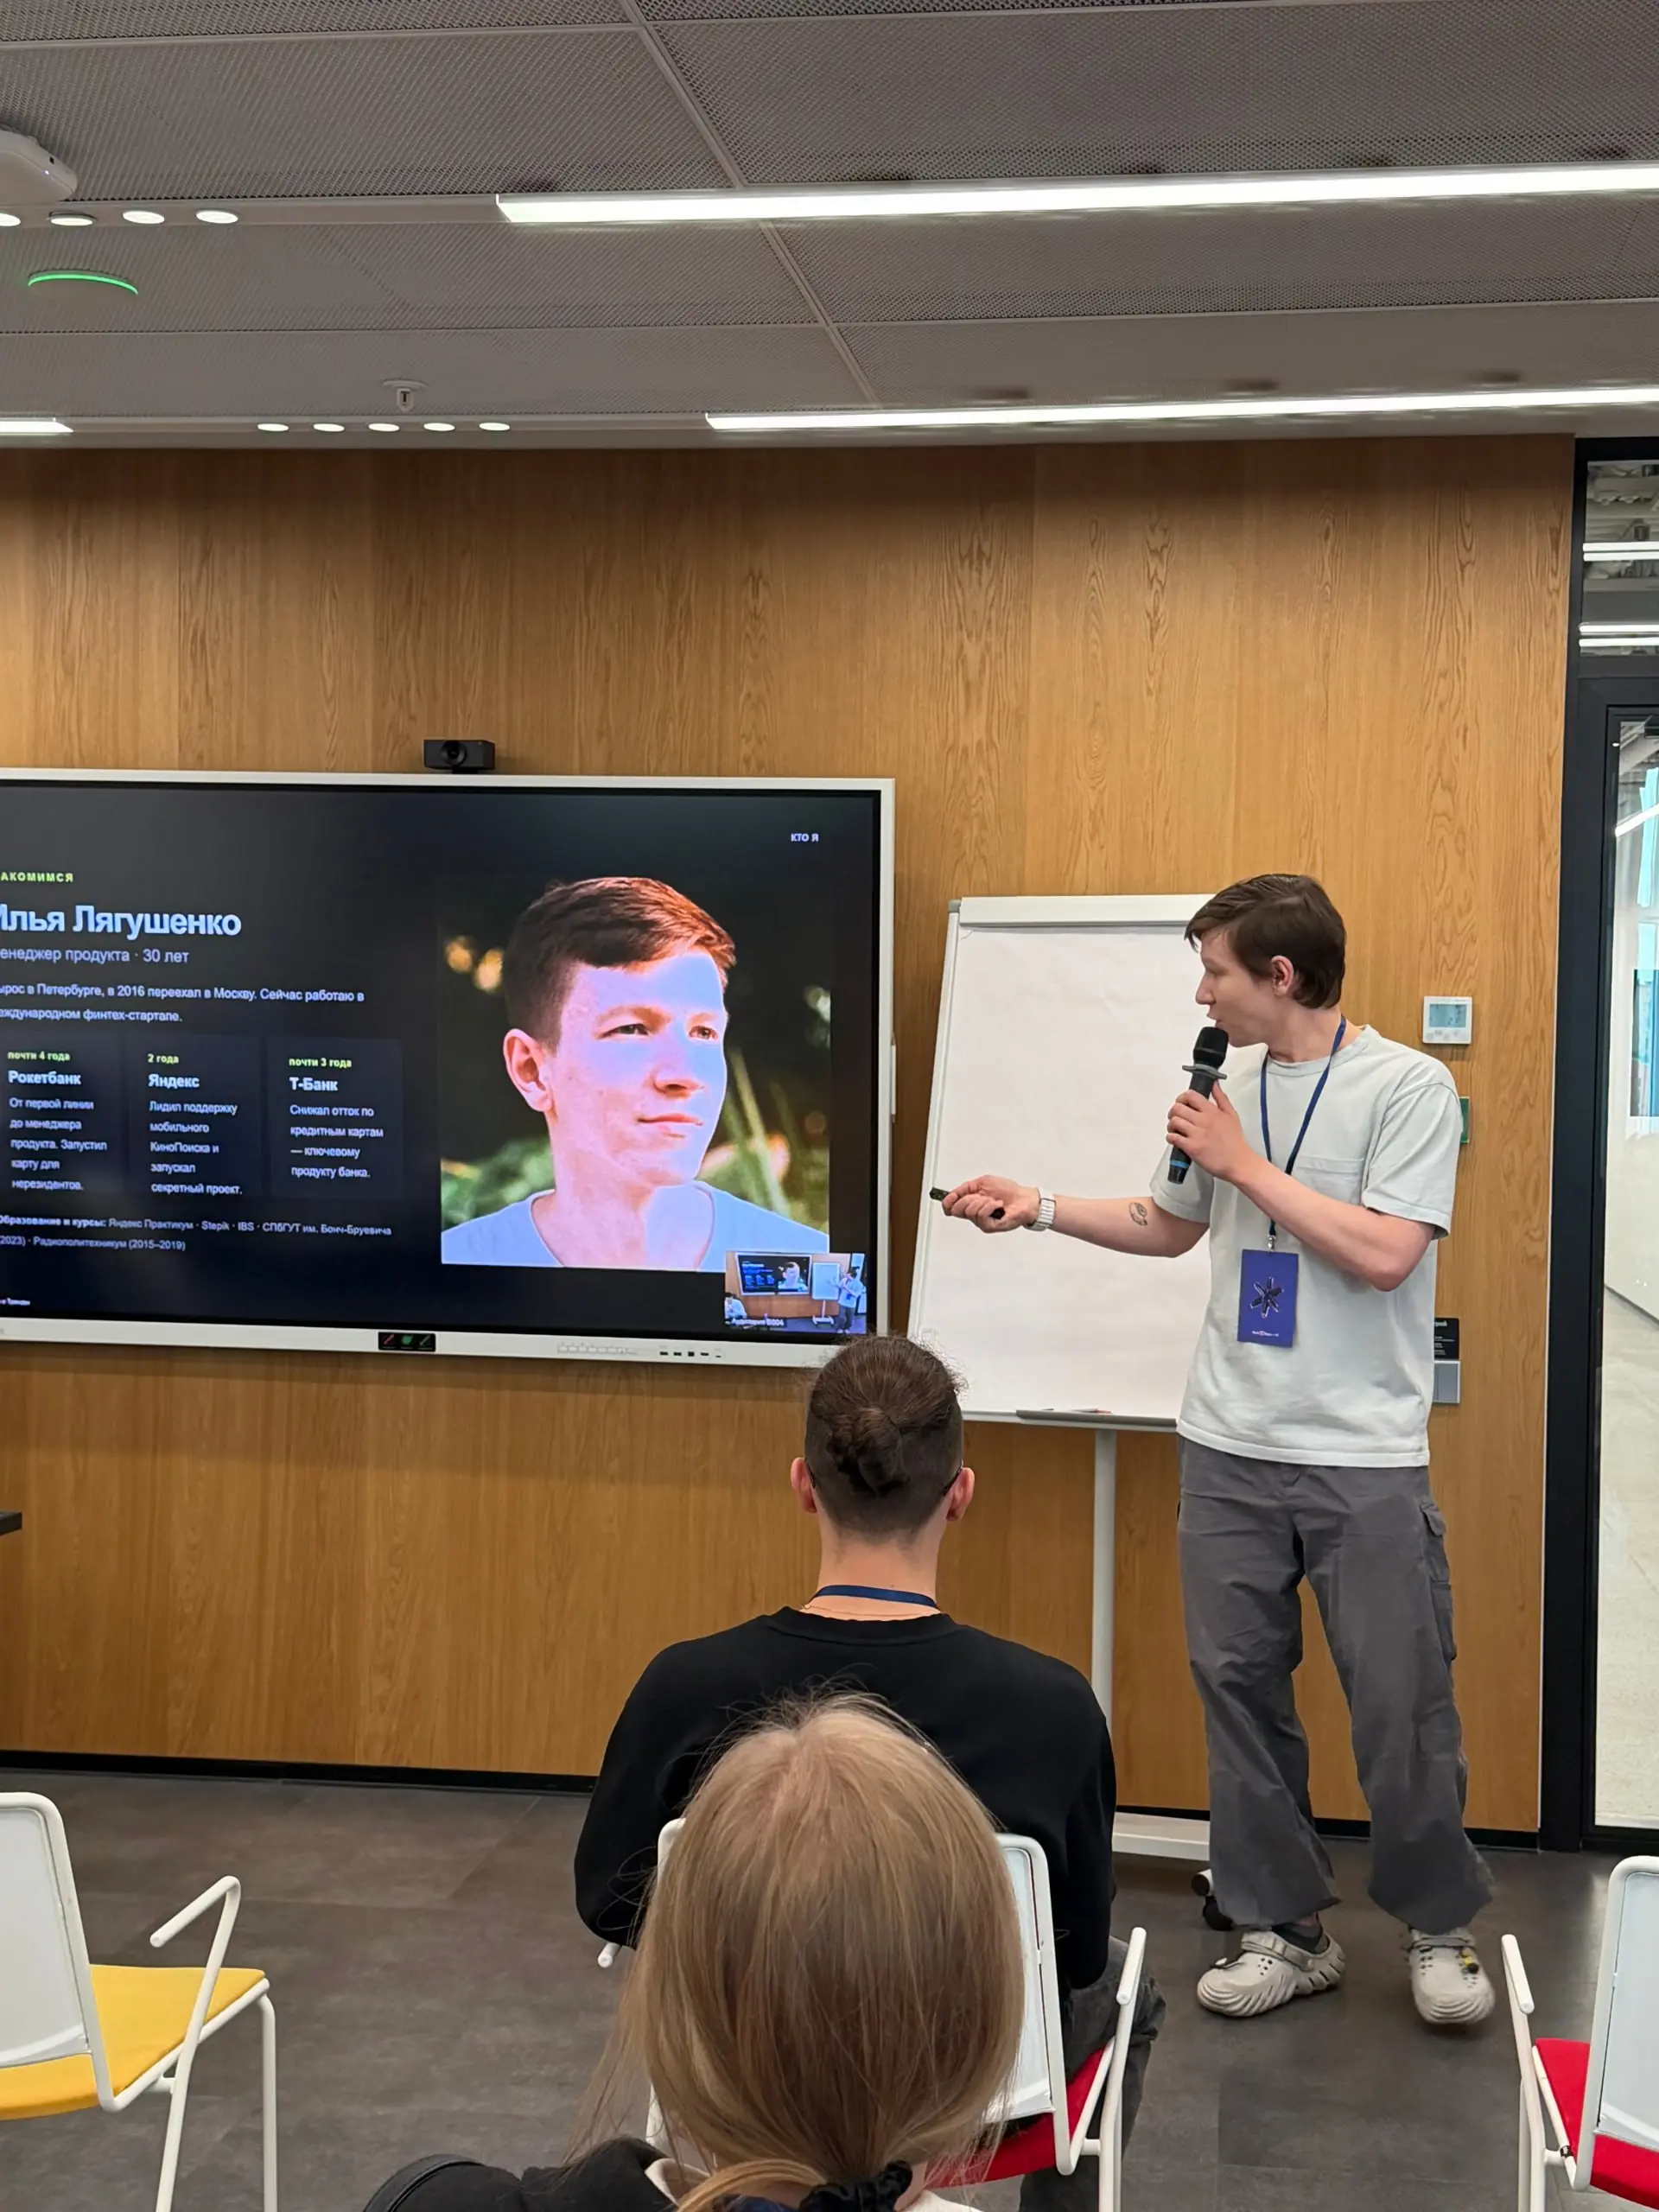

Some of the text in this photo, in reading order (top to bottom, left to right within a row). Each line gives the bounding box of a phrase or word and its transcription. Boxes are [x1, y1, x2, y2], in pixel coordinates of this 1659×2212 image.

[791, 833, 819, 842] КТО Я
[0, 872, 74, 882] АКОМИМСЯ
[73, 905, 242, 940] Лягушенко
[66, 950, 130, 964] продукта
[143, 949, 161, 963] 30
[164, 950, 189, 963] лет
[27, 985, 35, 995] в
[37, 982, 105, 998] Петербурге,
[107, 988, 115, 996] в
[117, 985, 145, 997] 2016
[148, 988, 201, 1000] переехал
[204, 989, 212, 999] в
[213, 988, 257, 1001] Москву.
[259, 988, 302, 1001] Сейчас
[305, 989, 354, 1002] работаю
[357, 993, 365, 1001] в
[83, 1008, 183, 1023] финтех-стартапе.
[8, 1051, 71, 1062] почти 4 года
[147, 1053, 179, 1065] 2 года
[289, 1058, 352, 1069] почти 3 года
[8, 1070, 82, 1085] Рокетбанк
[148, 1073, 200, 1090] Яндекс
[289, 1077, 339, 1091] Т-Банк
[9, 1096, 94, 1110] От первой линии
[149, 1100, 238, 1116] Лидил поддержку
[289, 1104, 374, 1117] Снижал отток по
[10, 1119, 82, 1132] до менеджера
[149, 1122, 209, 1134] мобильного
[289, 1126, 385, 1139] кредитным картам
[10, 1139, 108, 1152] продукта. Запустил
[150, 1141, 219, 1154] КиноПоиска и
[304, 1147, 360, 1160] ключевому
[11, 1159, 60, 1171] карту для
[150, 1162, 196, 1174] запускал
[291, 1166, 371, 1179] продукту банка.
[12, 1179, 84, 1192] нерезидентов.
[151, 1183, 243, 1196] секретный проект.
[108, 1217, 143, 1229] Яндекс
[143, 1219, 194, 1230] Практикум
[200, 1220, 230, 1232] Stepik
[238, 1221, 255, 1231] IBS
[262, 1221, 302, 1233] СПбГУТ
[302, 1225, 319, 1234] им.
[321, 1224, 392, 1236] Бонч-Бруевича
